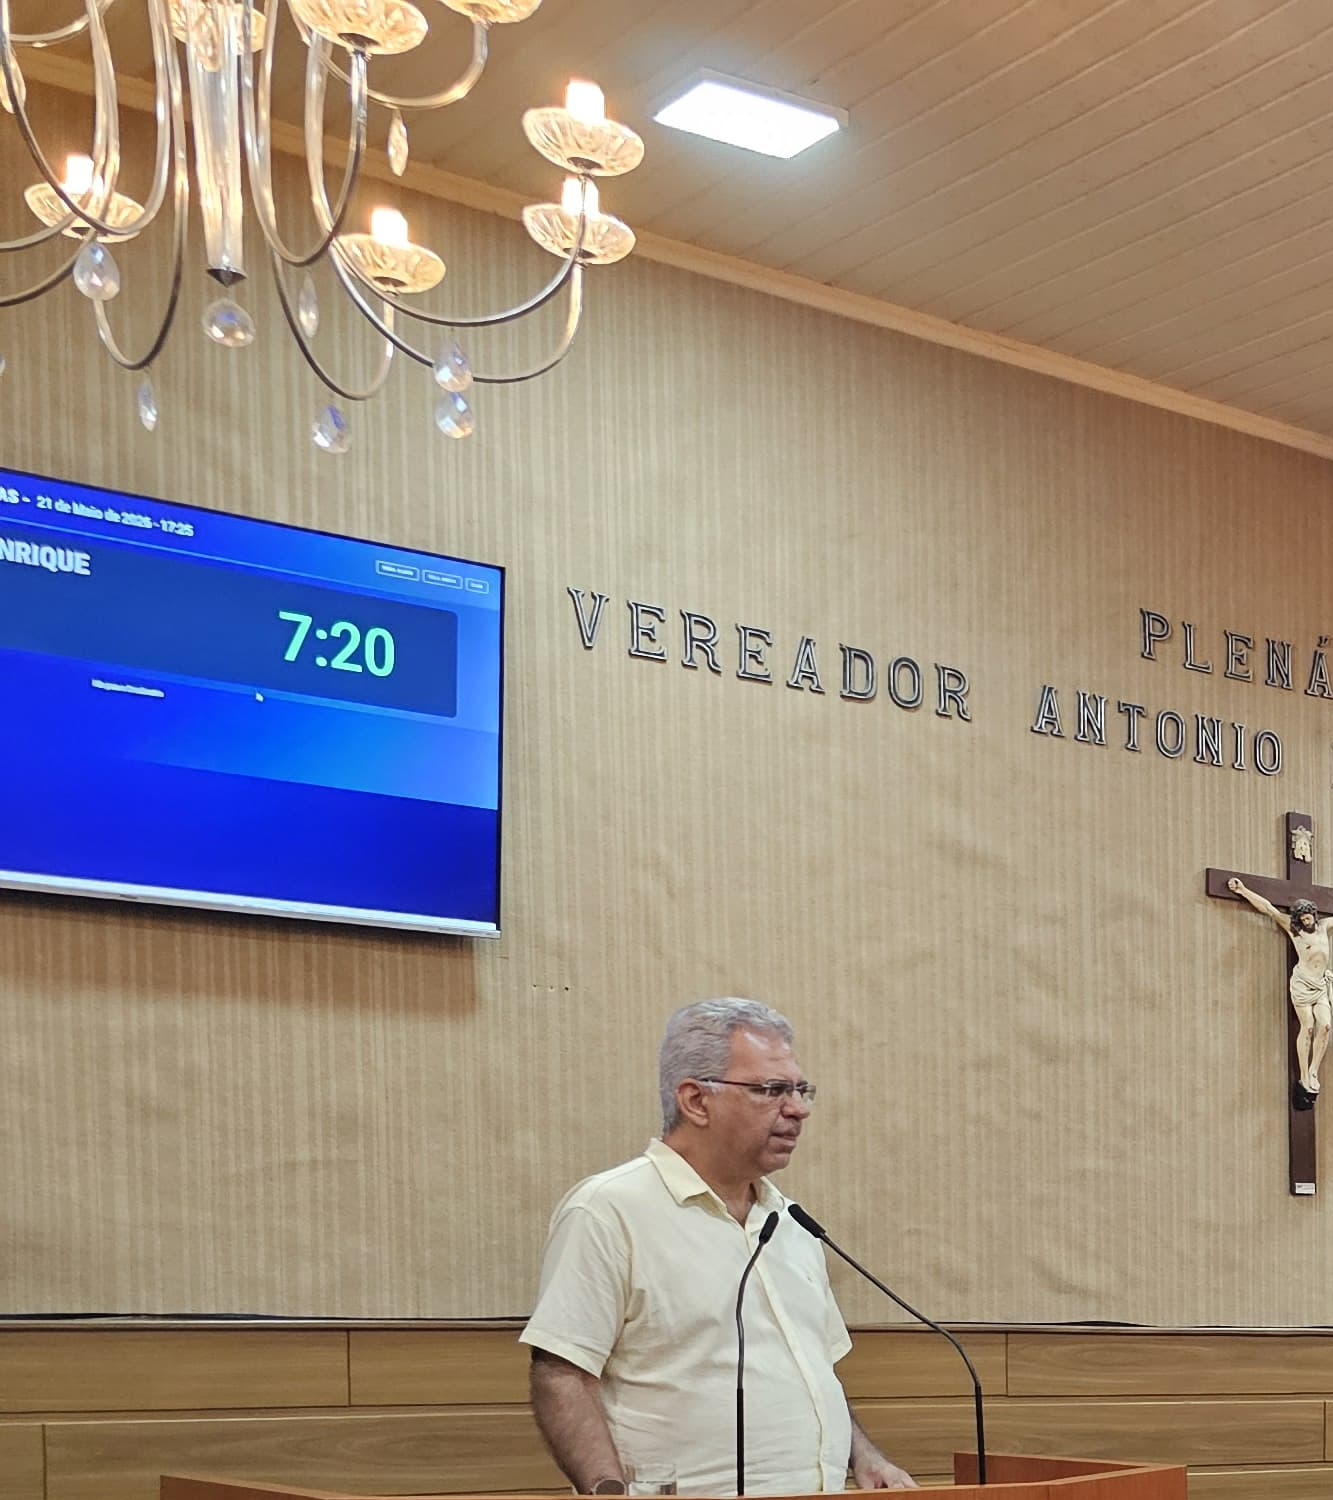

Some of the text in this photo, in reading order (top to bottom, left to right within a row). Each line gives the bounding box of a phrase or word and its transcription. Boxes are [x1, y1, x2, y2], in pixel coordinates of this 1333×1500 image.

[36, 495, 52, 510] 21
[278, 610, 395, 677] 7:20
[567, 587, 971, 721] VEREADOR
[1031, 685, 1283, 777] ANTONIO
